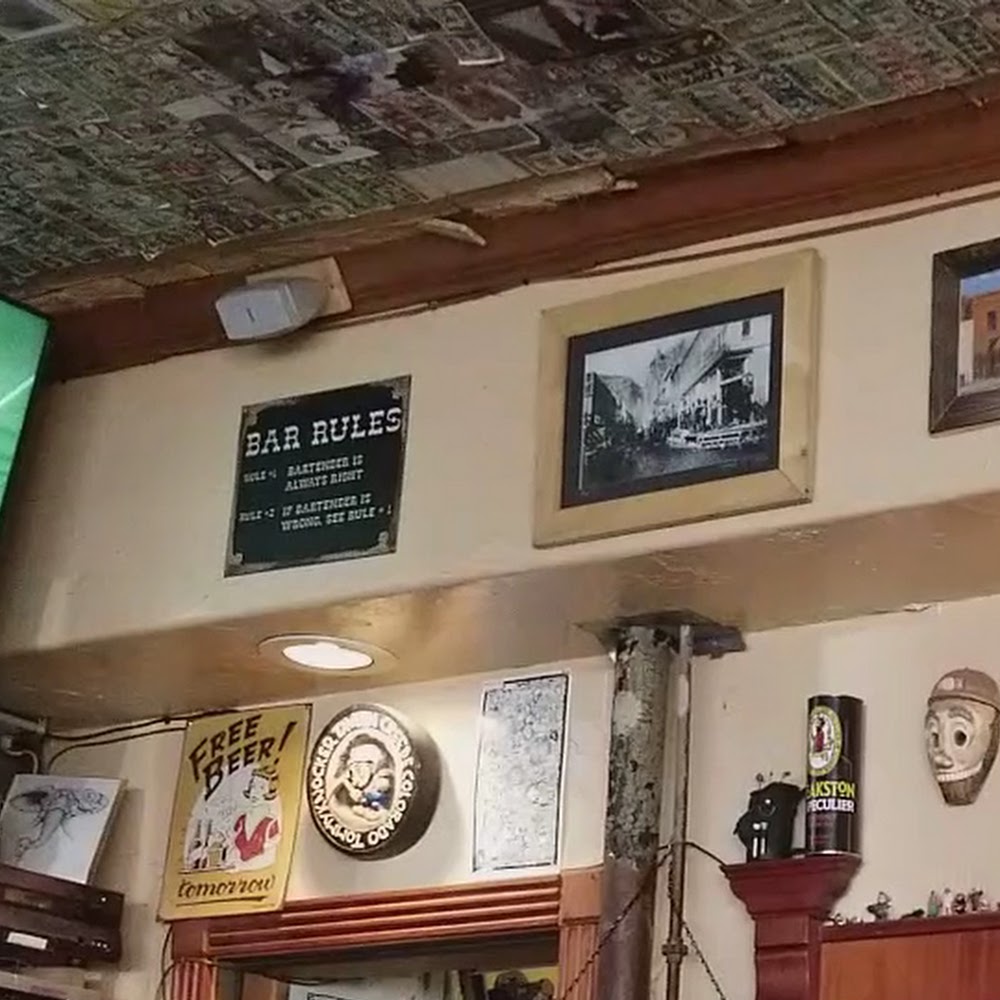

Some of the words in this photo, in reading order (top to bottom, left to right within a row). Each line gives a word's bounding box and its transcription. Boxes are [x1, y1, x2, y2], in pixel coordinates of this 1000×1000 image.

[245, 425, 300, 457] BAR
[311, 408, 402, 445] RULES
[287, 457, 349, 477] BARTENDER
[352, 455, 363, 466] IS
[285, 475, 328, 491] ALWAYS
[330, 469, 364, 484] RIGHT
[296, 495, 357, 515] BARTENDER
[360, 493, 371, 504] IS
[326, 512, 345, 525] SEE
[348, 507, 376, 521] RULE
[188, 714, 262, 783] FREE
[204, 721, 297, 801] BEER!
[808, 780, 855, 798] AKSTON
[177, 875, 275, 898] tomorrow
